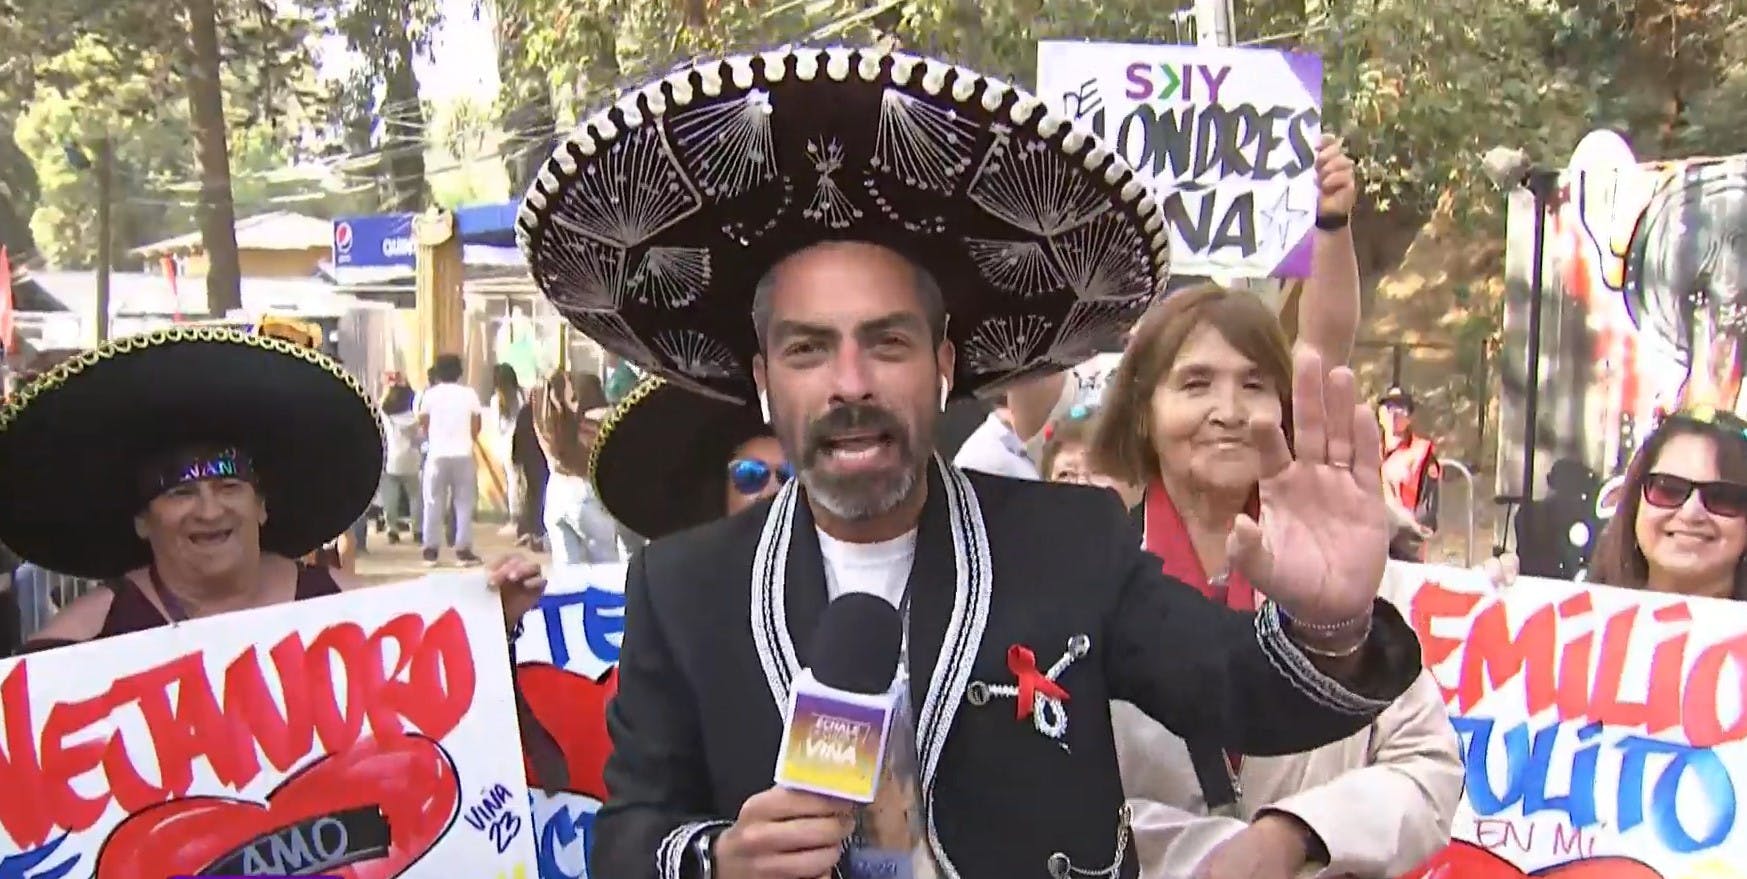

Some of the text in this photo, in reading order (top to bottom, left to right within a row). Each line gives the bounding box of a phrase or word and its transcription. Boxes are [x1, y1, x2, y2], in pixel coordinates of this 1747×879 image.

[1162, 180, 1258, 259] ÑA
[0, 606, 476, 851] LEJANDRO
[243, 816, 349, 877] AMO
[489, 811, 522, 855] 23
[1474, 820, 1536, 854] EN
